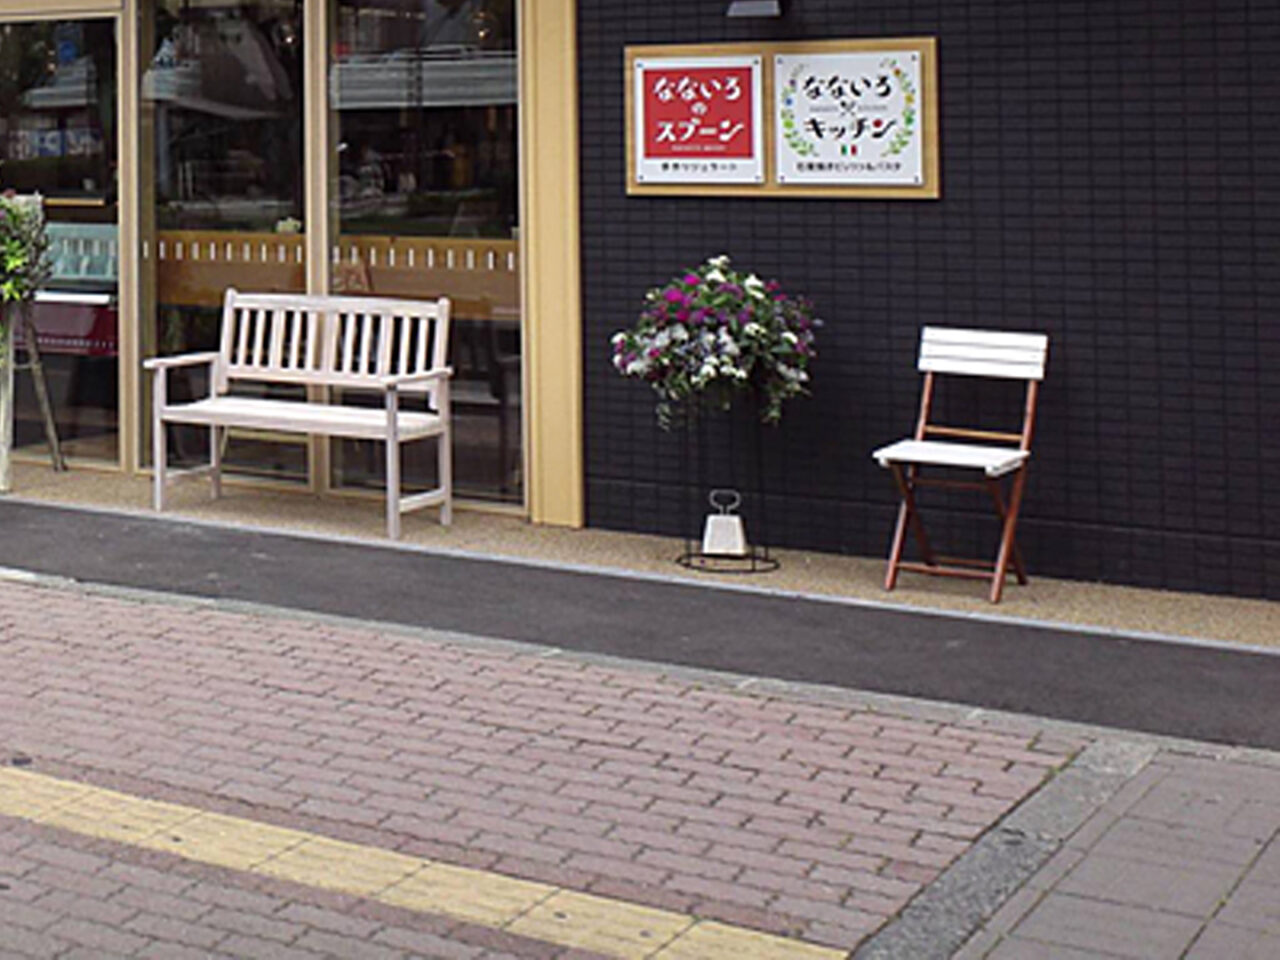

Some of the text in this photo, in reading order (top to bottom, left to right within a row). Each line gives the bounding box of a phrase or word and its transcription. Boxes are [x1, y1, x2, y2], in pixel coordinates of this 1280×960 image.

[653, 76, 742, 102] なないろ
[802, 76, 892, 100] なないろ
[655, 117, 744, 142] スプーン
[803, 118, 897, 139] キッチン
